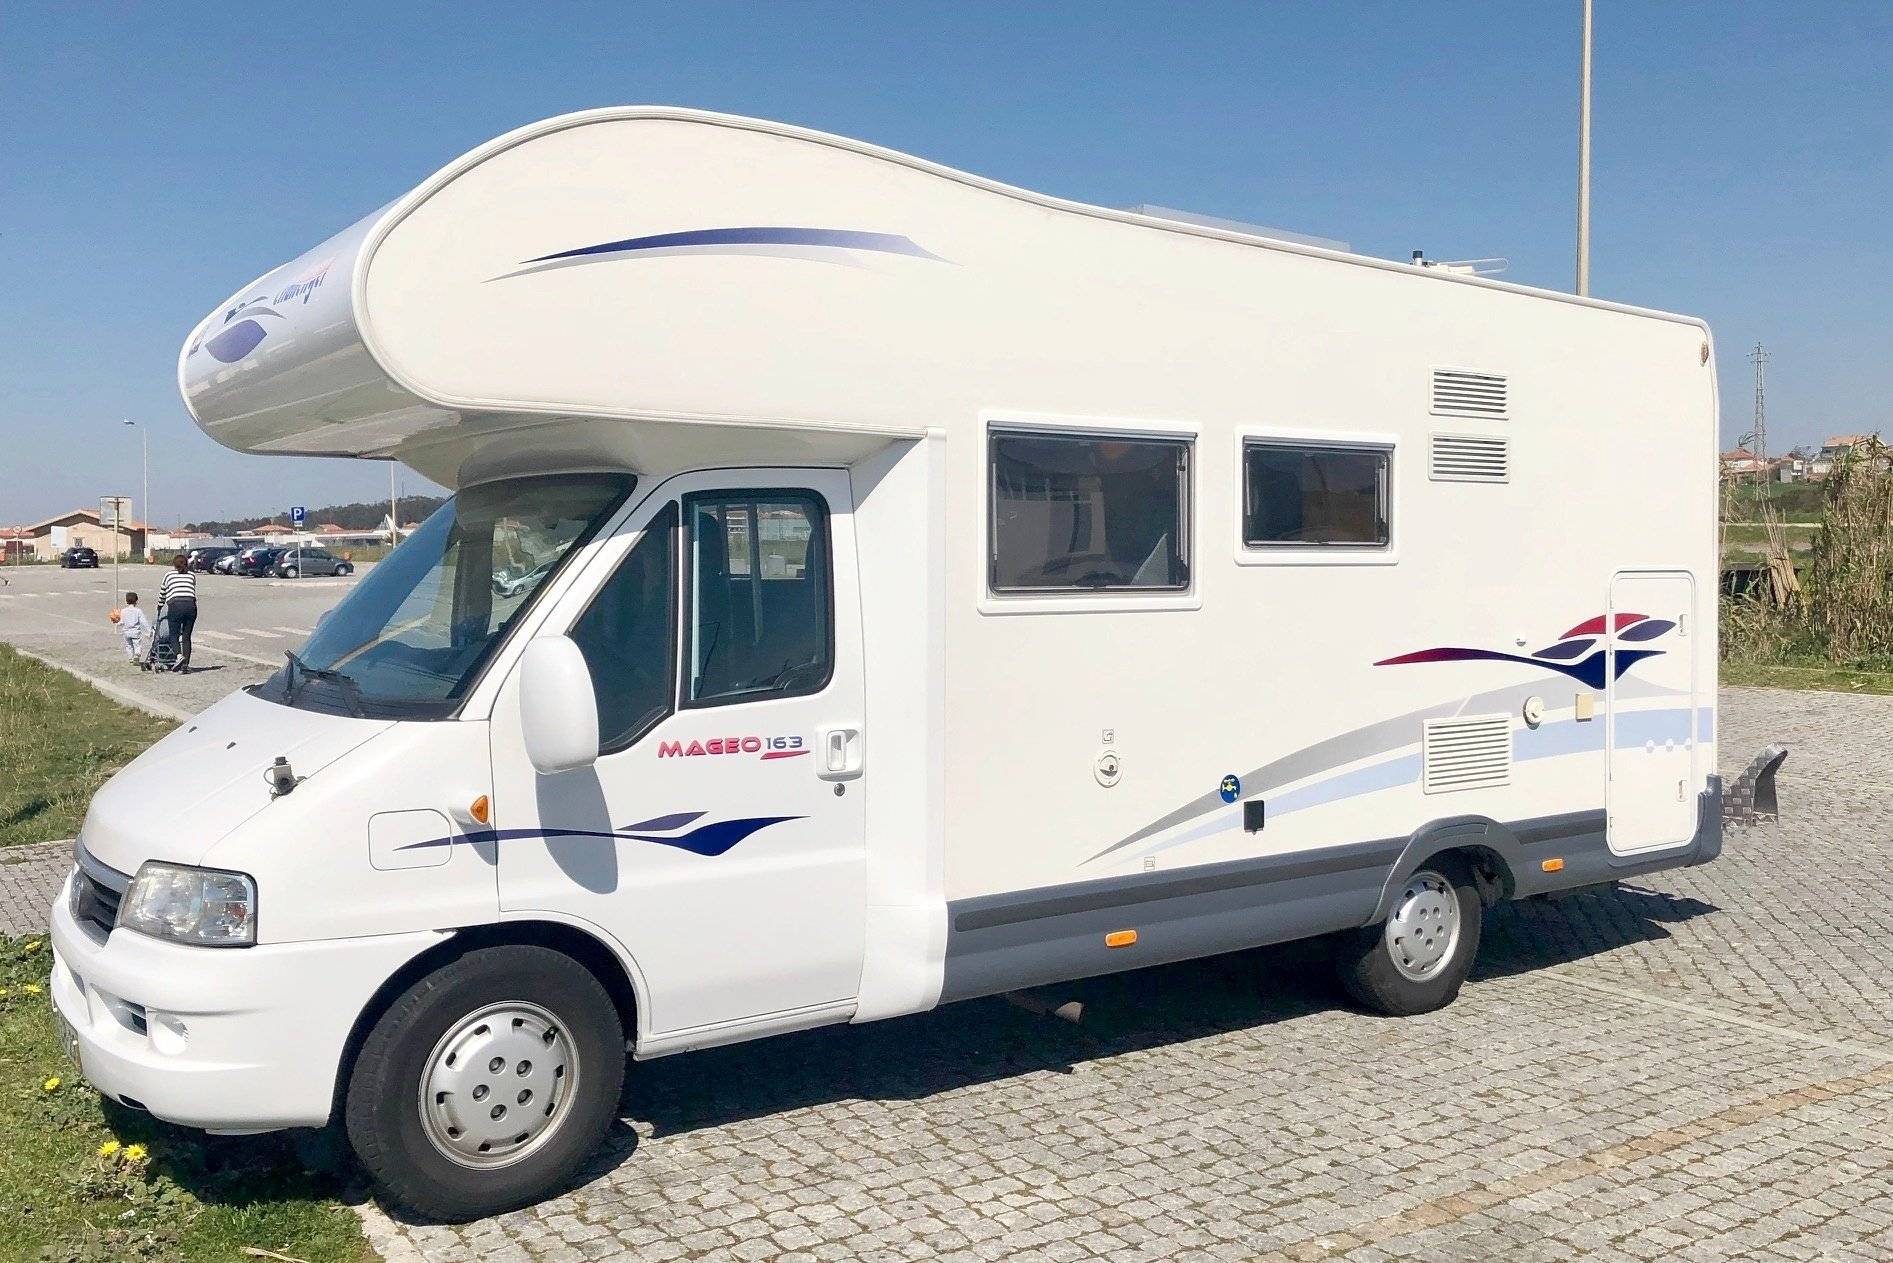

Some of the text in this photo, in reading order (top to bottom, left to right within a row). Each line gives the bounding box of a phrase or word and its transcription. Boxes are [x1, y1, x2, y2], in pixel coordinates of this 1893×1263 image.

[293, 508, 303, 520] P
[658, 735, 803, 758] MAGEO 163
